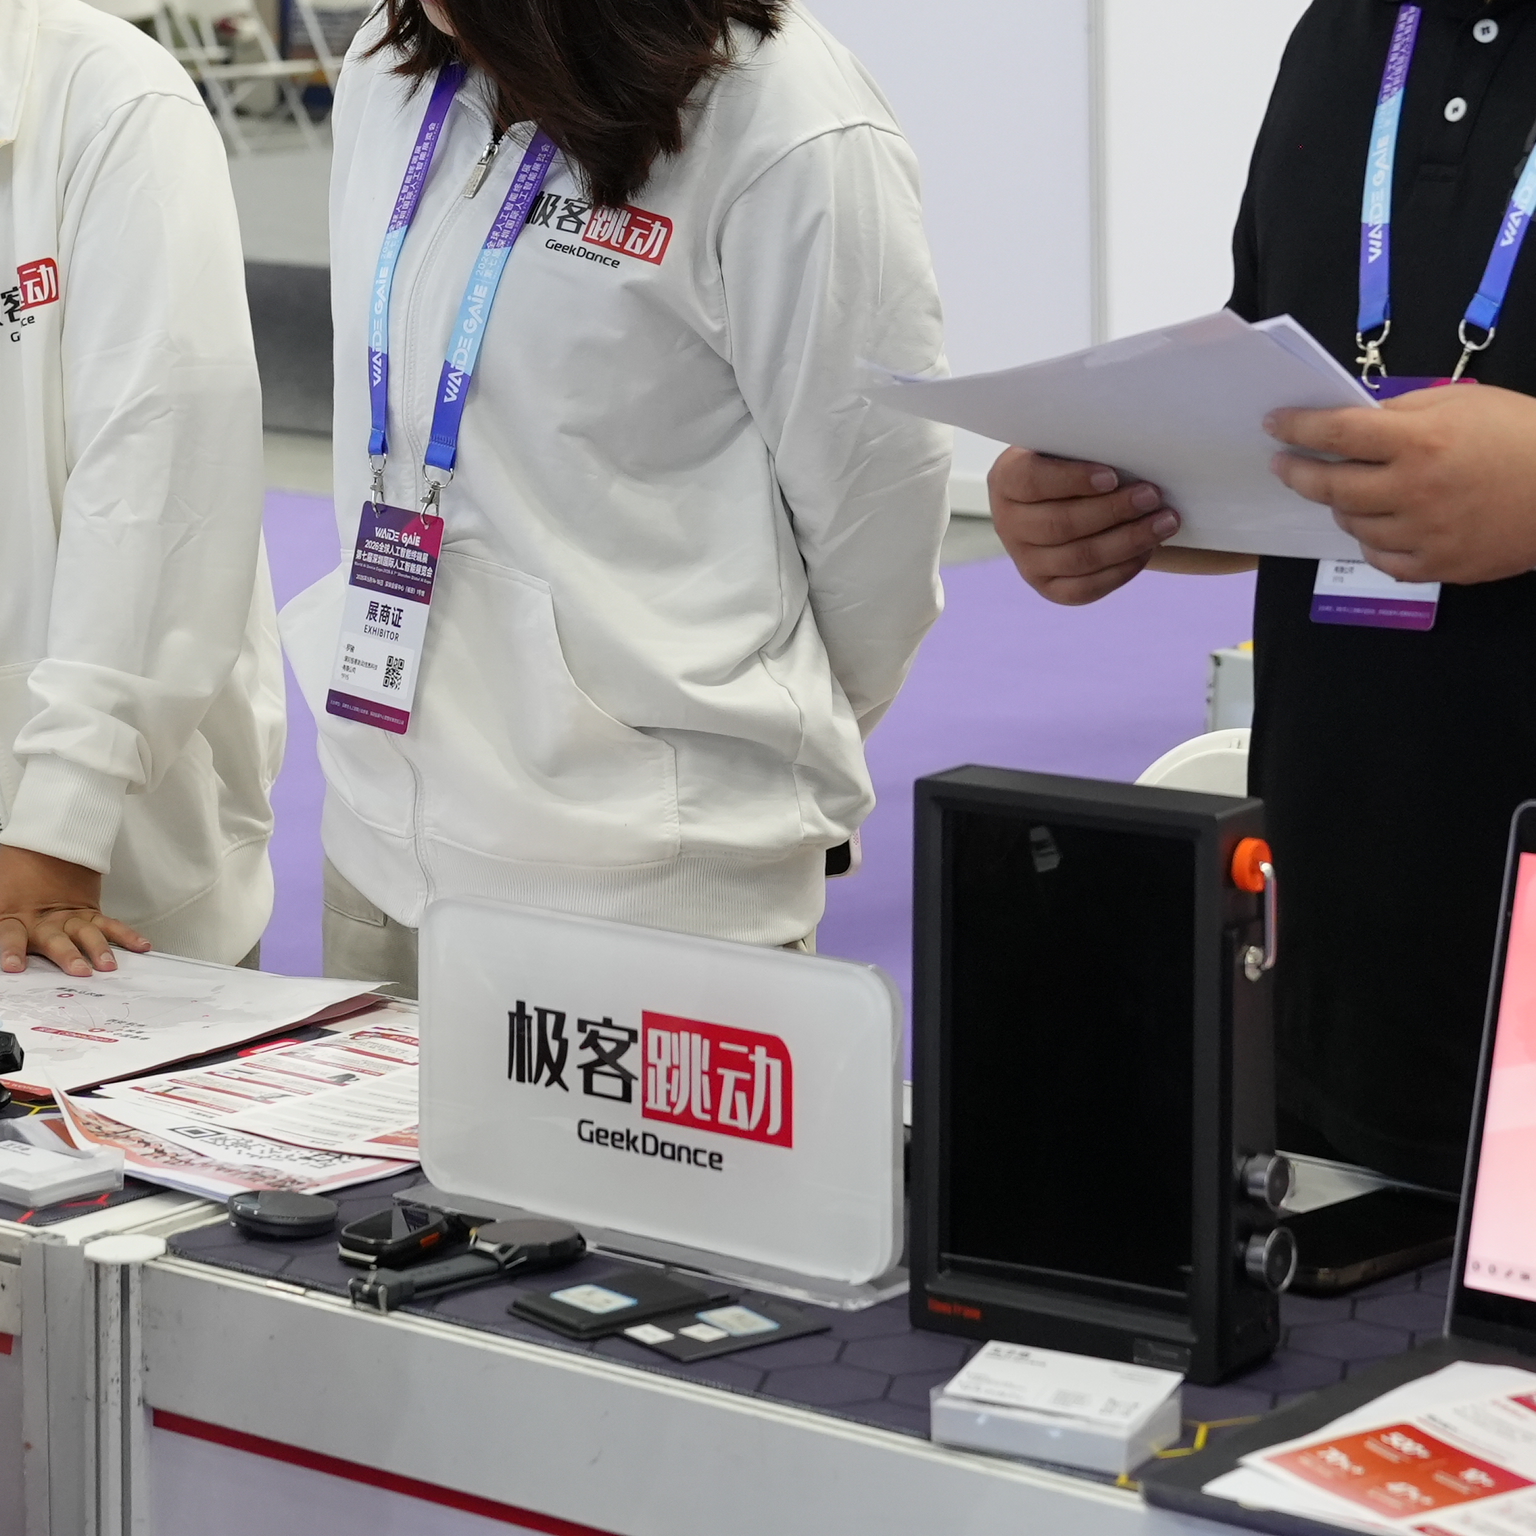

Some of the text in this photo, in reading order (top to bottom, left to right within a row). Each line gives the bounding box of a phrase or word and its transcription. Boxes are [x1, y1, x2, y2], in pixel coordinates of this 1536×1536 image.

[545, 238, 621, 269] GeekDance
[365, 600, 404, 629] 展商证
[363, 624, 400, 642] EXHIBITOR
[507, 999, 783, 1137] 极客跳动
[576, 1118, 724, 1172] GeekDance
